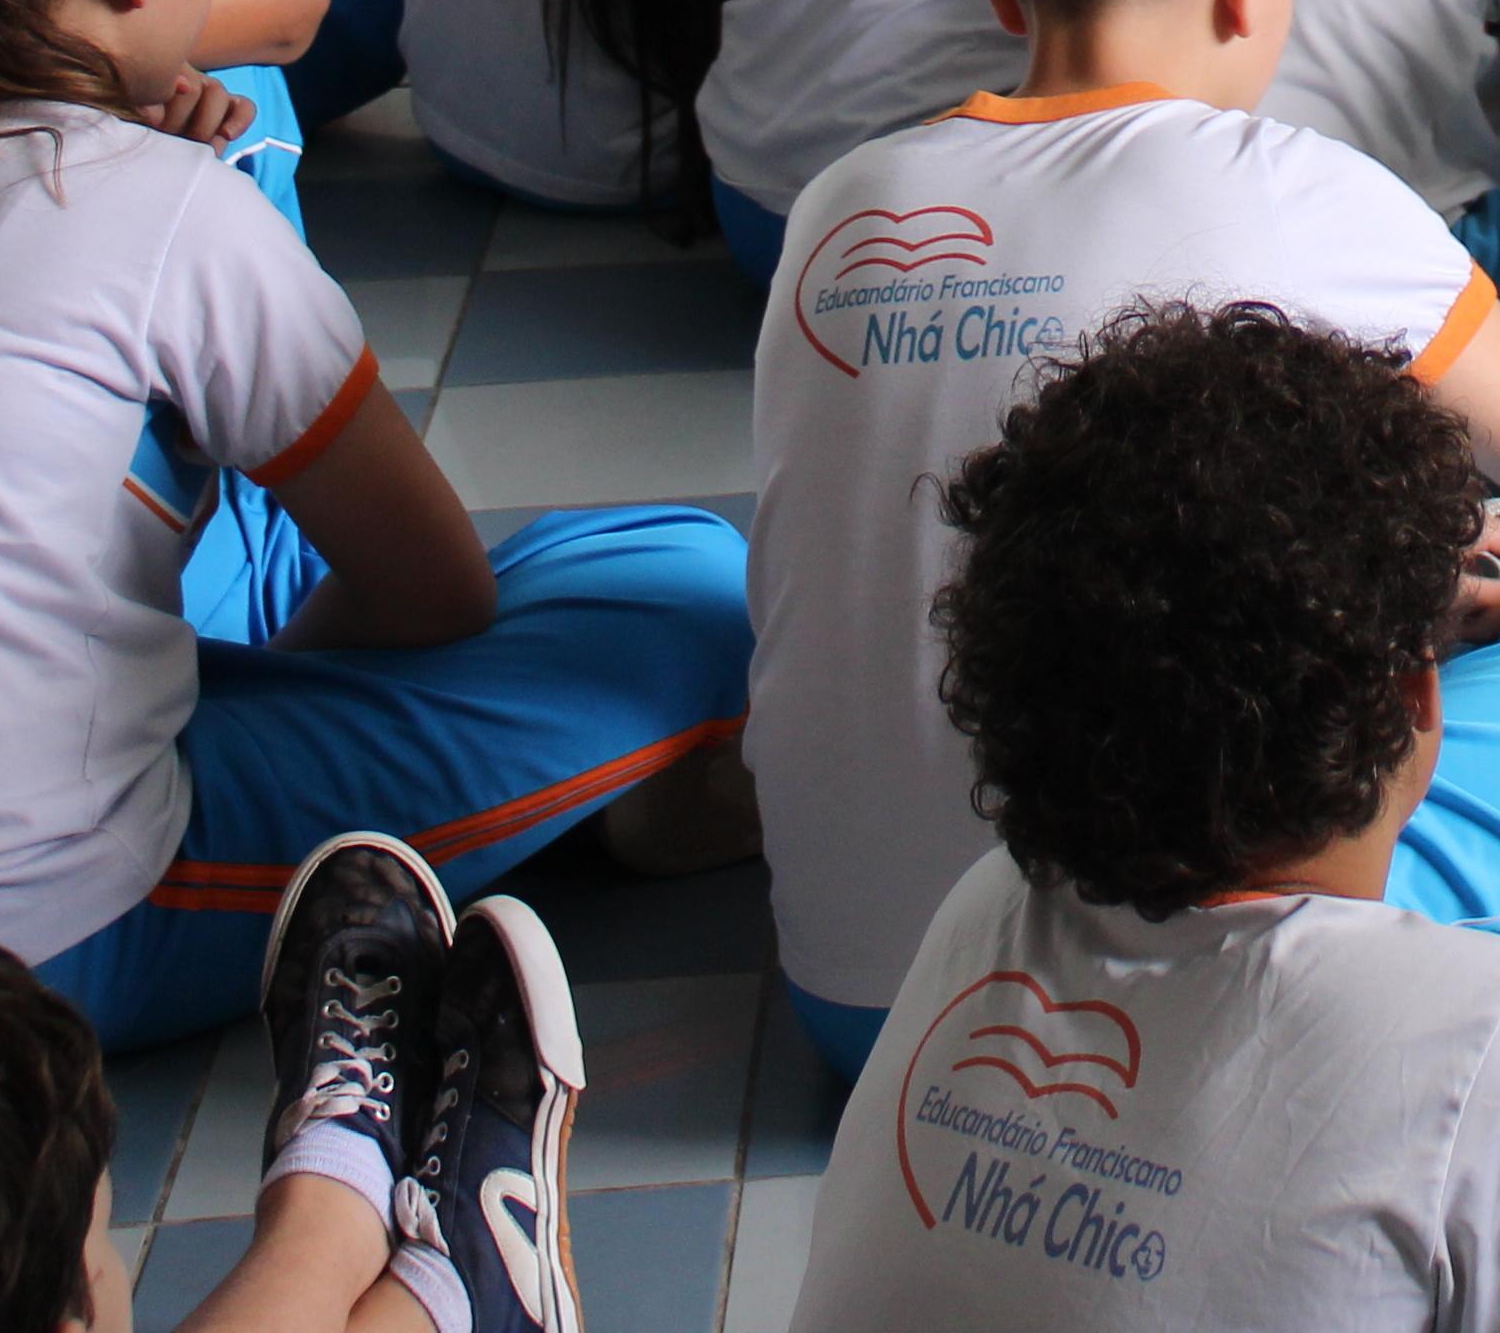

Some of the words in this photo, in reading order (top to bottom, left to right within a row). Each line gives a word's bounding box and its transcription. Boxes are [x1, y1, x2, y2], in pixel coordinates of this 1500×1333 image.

[814, 279, 934, 315] Educandário
[938, 273, 1065, 300] Franciscano
[861, 309, 944, 367] Nhá
[916, 1086, 1050, 1156] Educandário
[1048, 1127, 1183, 1196] Franciscano
[942, 1151, 1047, 1247] Nhá
